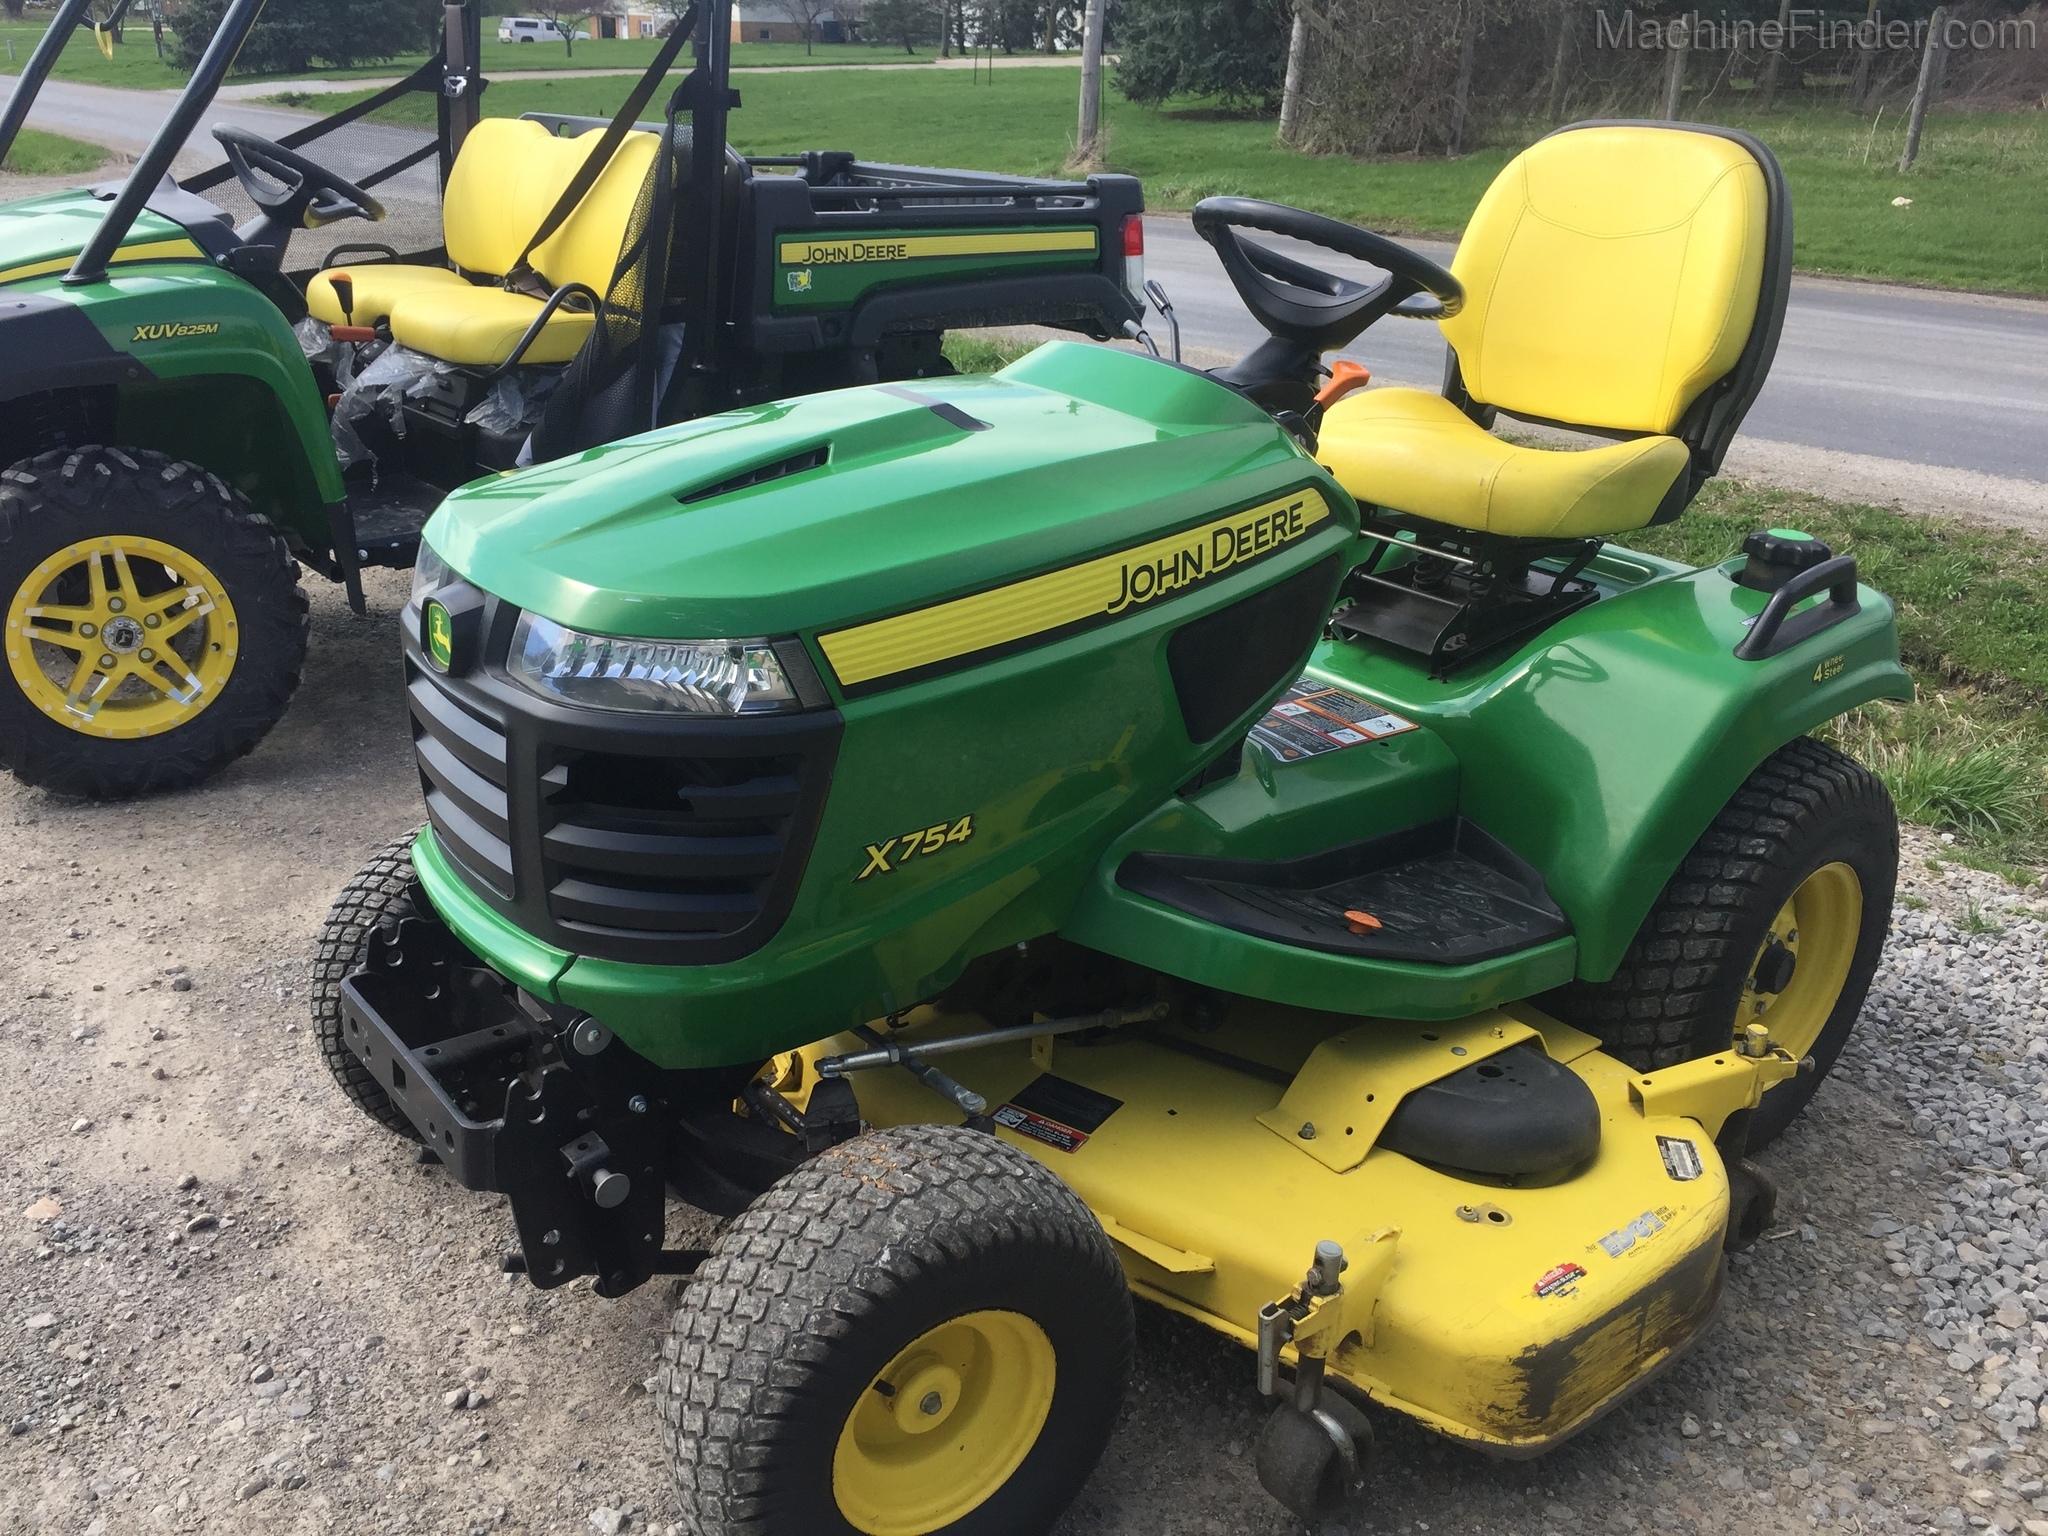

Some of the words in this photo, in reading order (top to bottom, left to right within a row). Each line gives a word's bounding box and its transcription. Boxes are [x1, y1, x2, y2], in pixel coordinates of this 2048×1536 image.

[802, 245, 849, 263] JOHN
[852, 243, 907, 260] DEERE
[131, 322, 219, 342] XUV825M
[1107, 543, 1203, 612] JOHN
[1212, 500, 1304, 569] DEERE
[1824, 654, 1845, 670] Whee
[1813, 663, 1823, 682] 4
[854, 814, 973, 881] X754
[1045, 1121, 1073, 1135] DANGER
[1655, 1205, 1670, 1217] HIGH
[1597, 1210, 1667, 1259] EDGE
